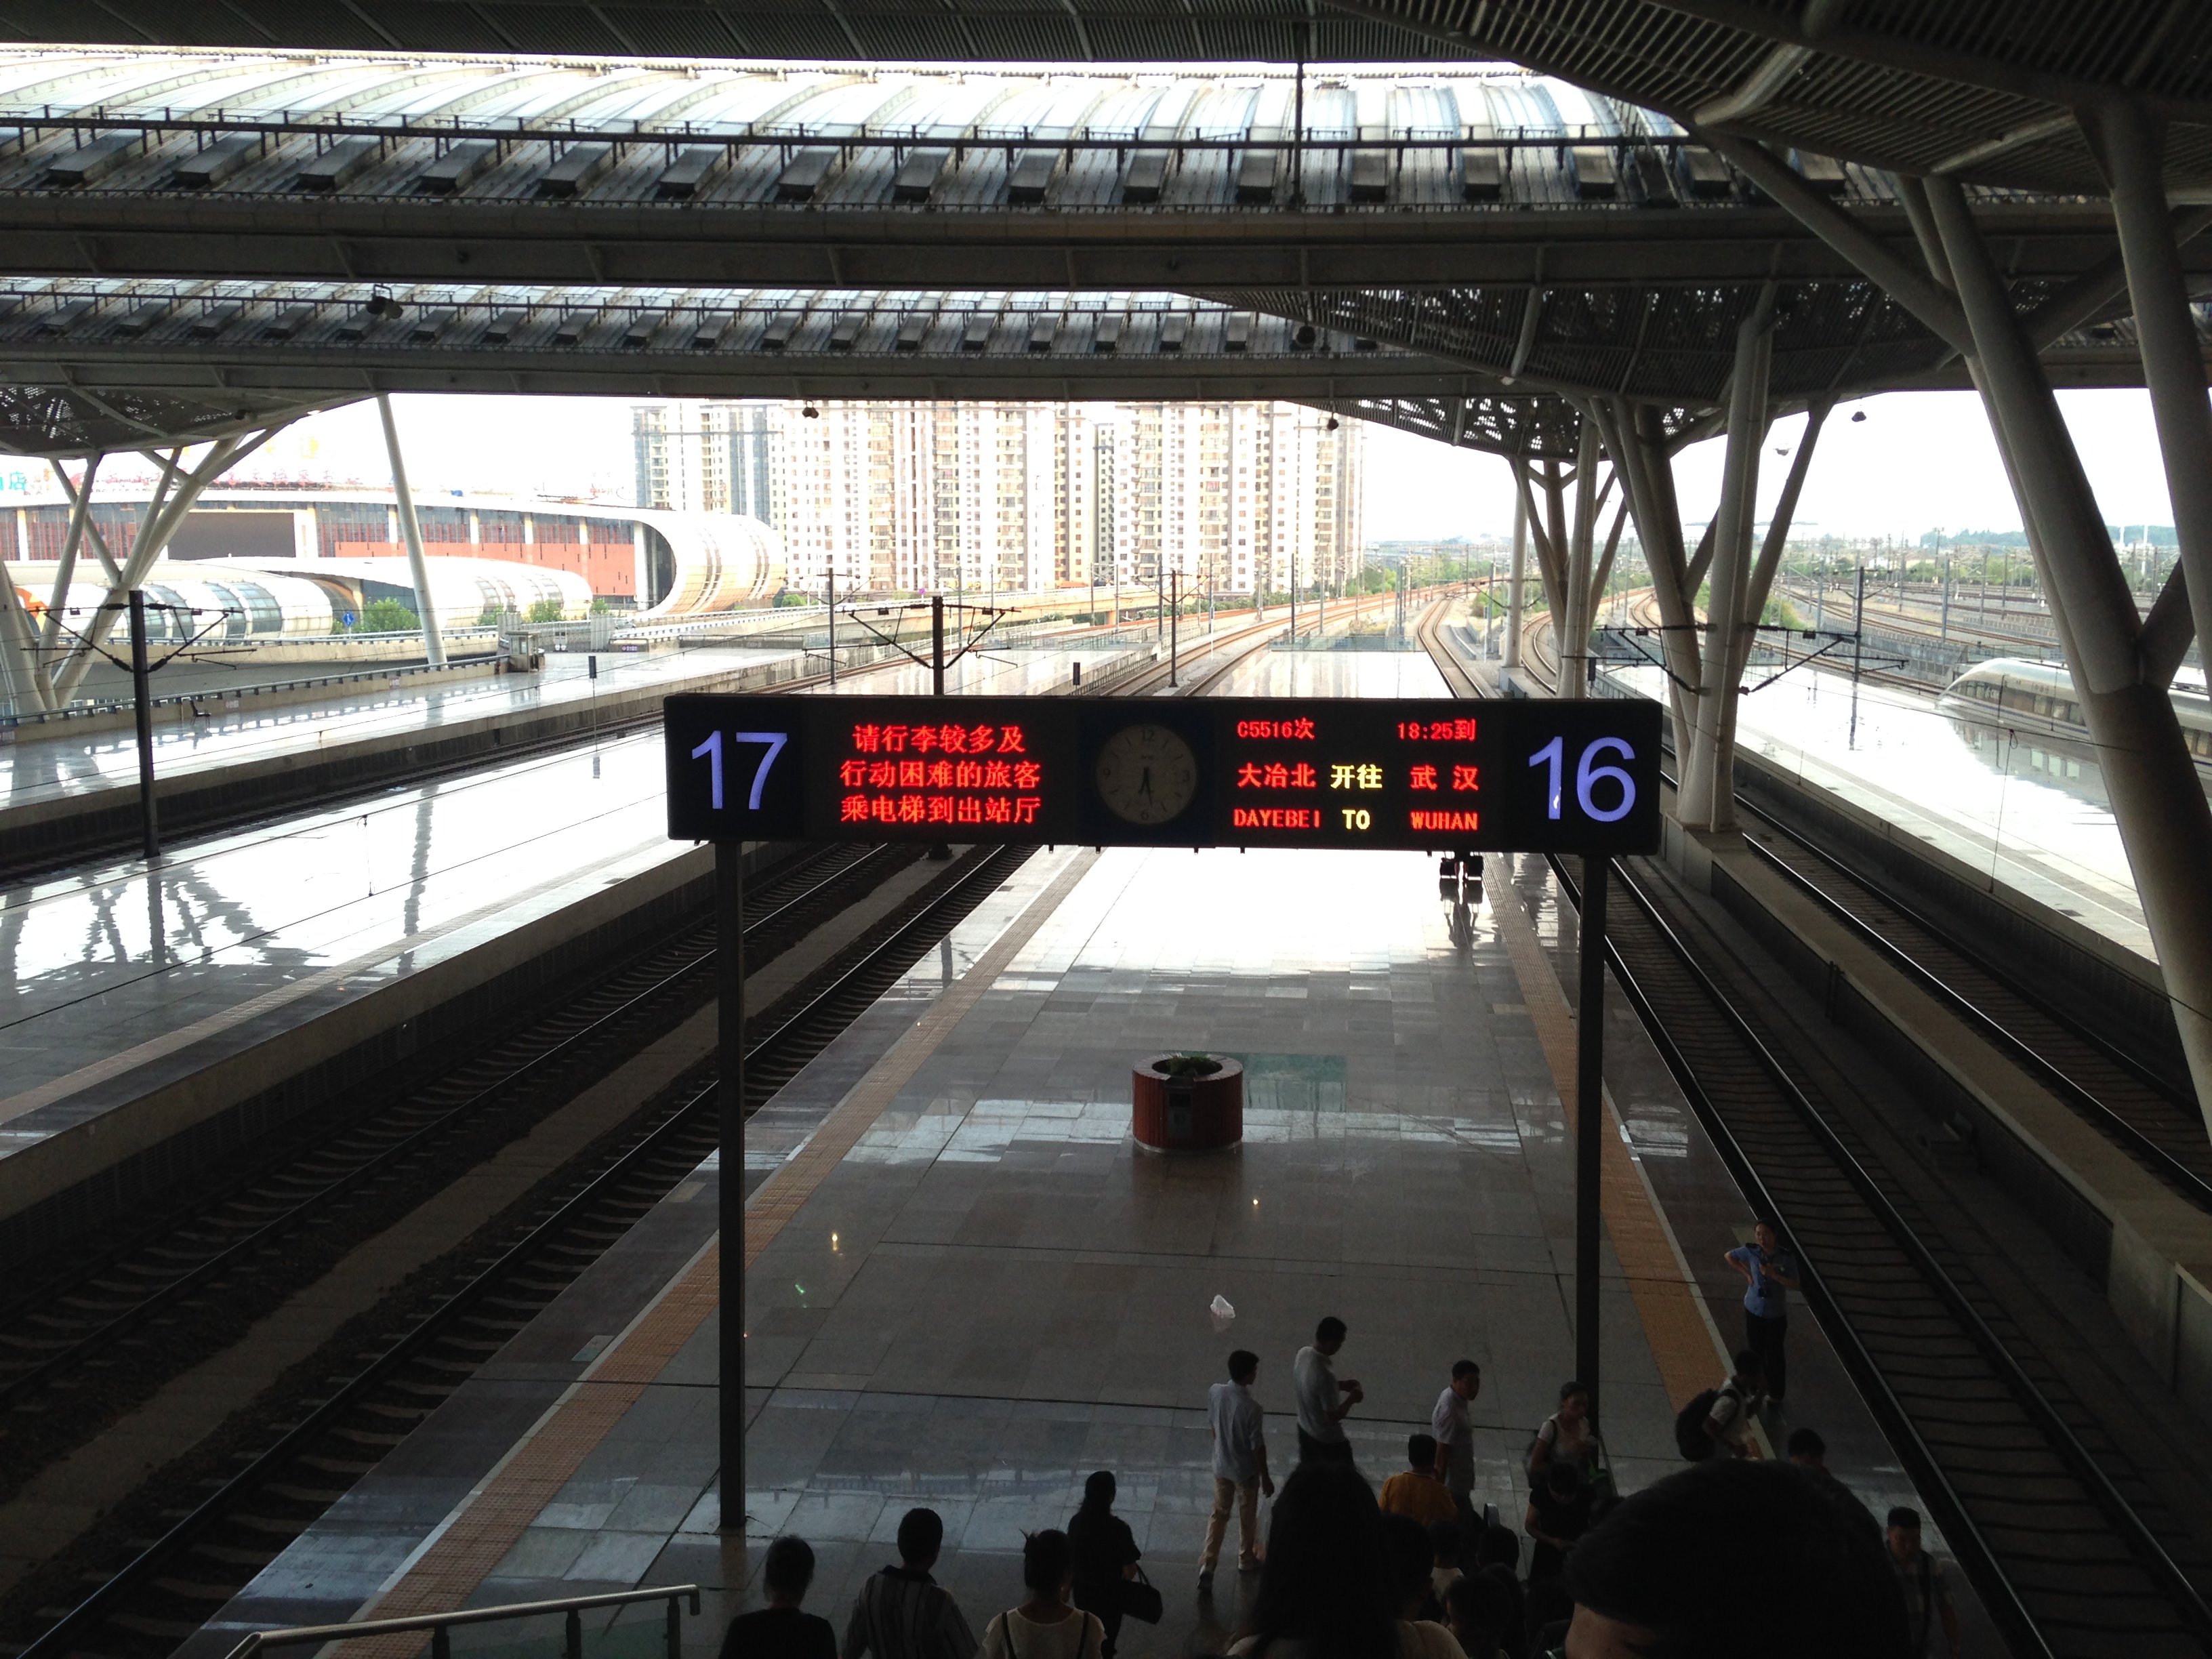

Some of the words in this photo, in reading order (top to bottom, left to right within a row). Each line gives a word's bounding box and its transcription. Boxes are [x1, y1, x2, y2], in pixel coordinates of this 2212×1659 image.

[852, 723, 1027, 755] 请行李较多及
[1237, 717, 1315, 740] C5516次
[1397, 718, 1477, 742] 18:25到
[691, 730, 787, 810] 17
[839, 759, 1042, 790] 行动困难的旅客
[1237, 762, 1317, 790] 大冶北
[1330, 763, 1383, 790] 开往
[1528, 736, 1636, 823] 16
[840, 794, 1042, 825] 乘电梯到出站厅
[1341, 808, 1371, 830] TO
[1410, 811, 1479, 832] WUHAN
